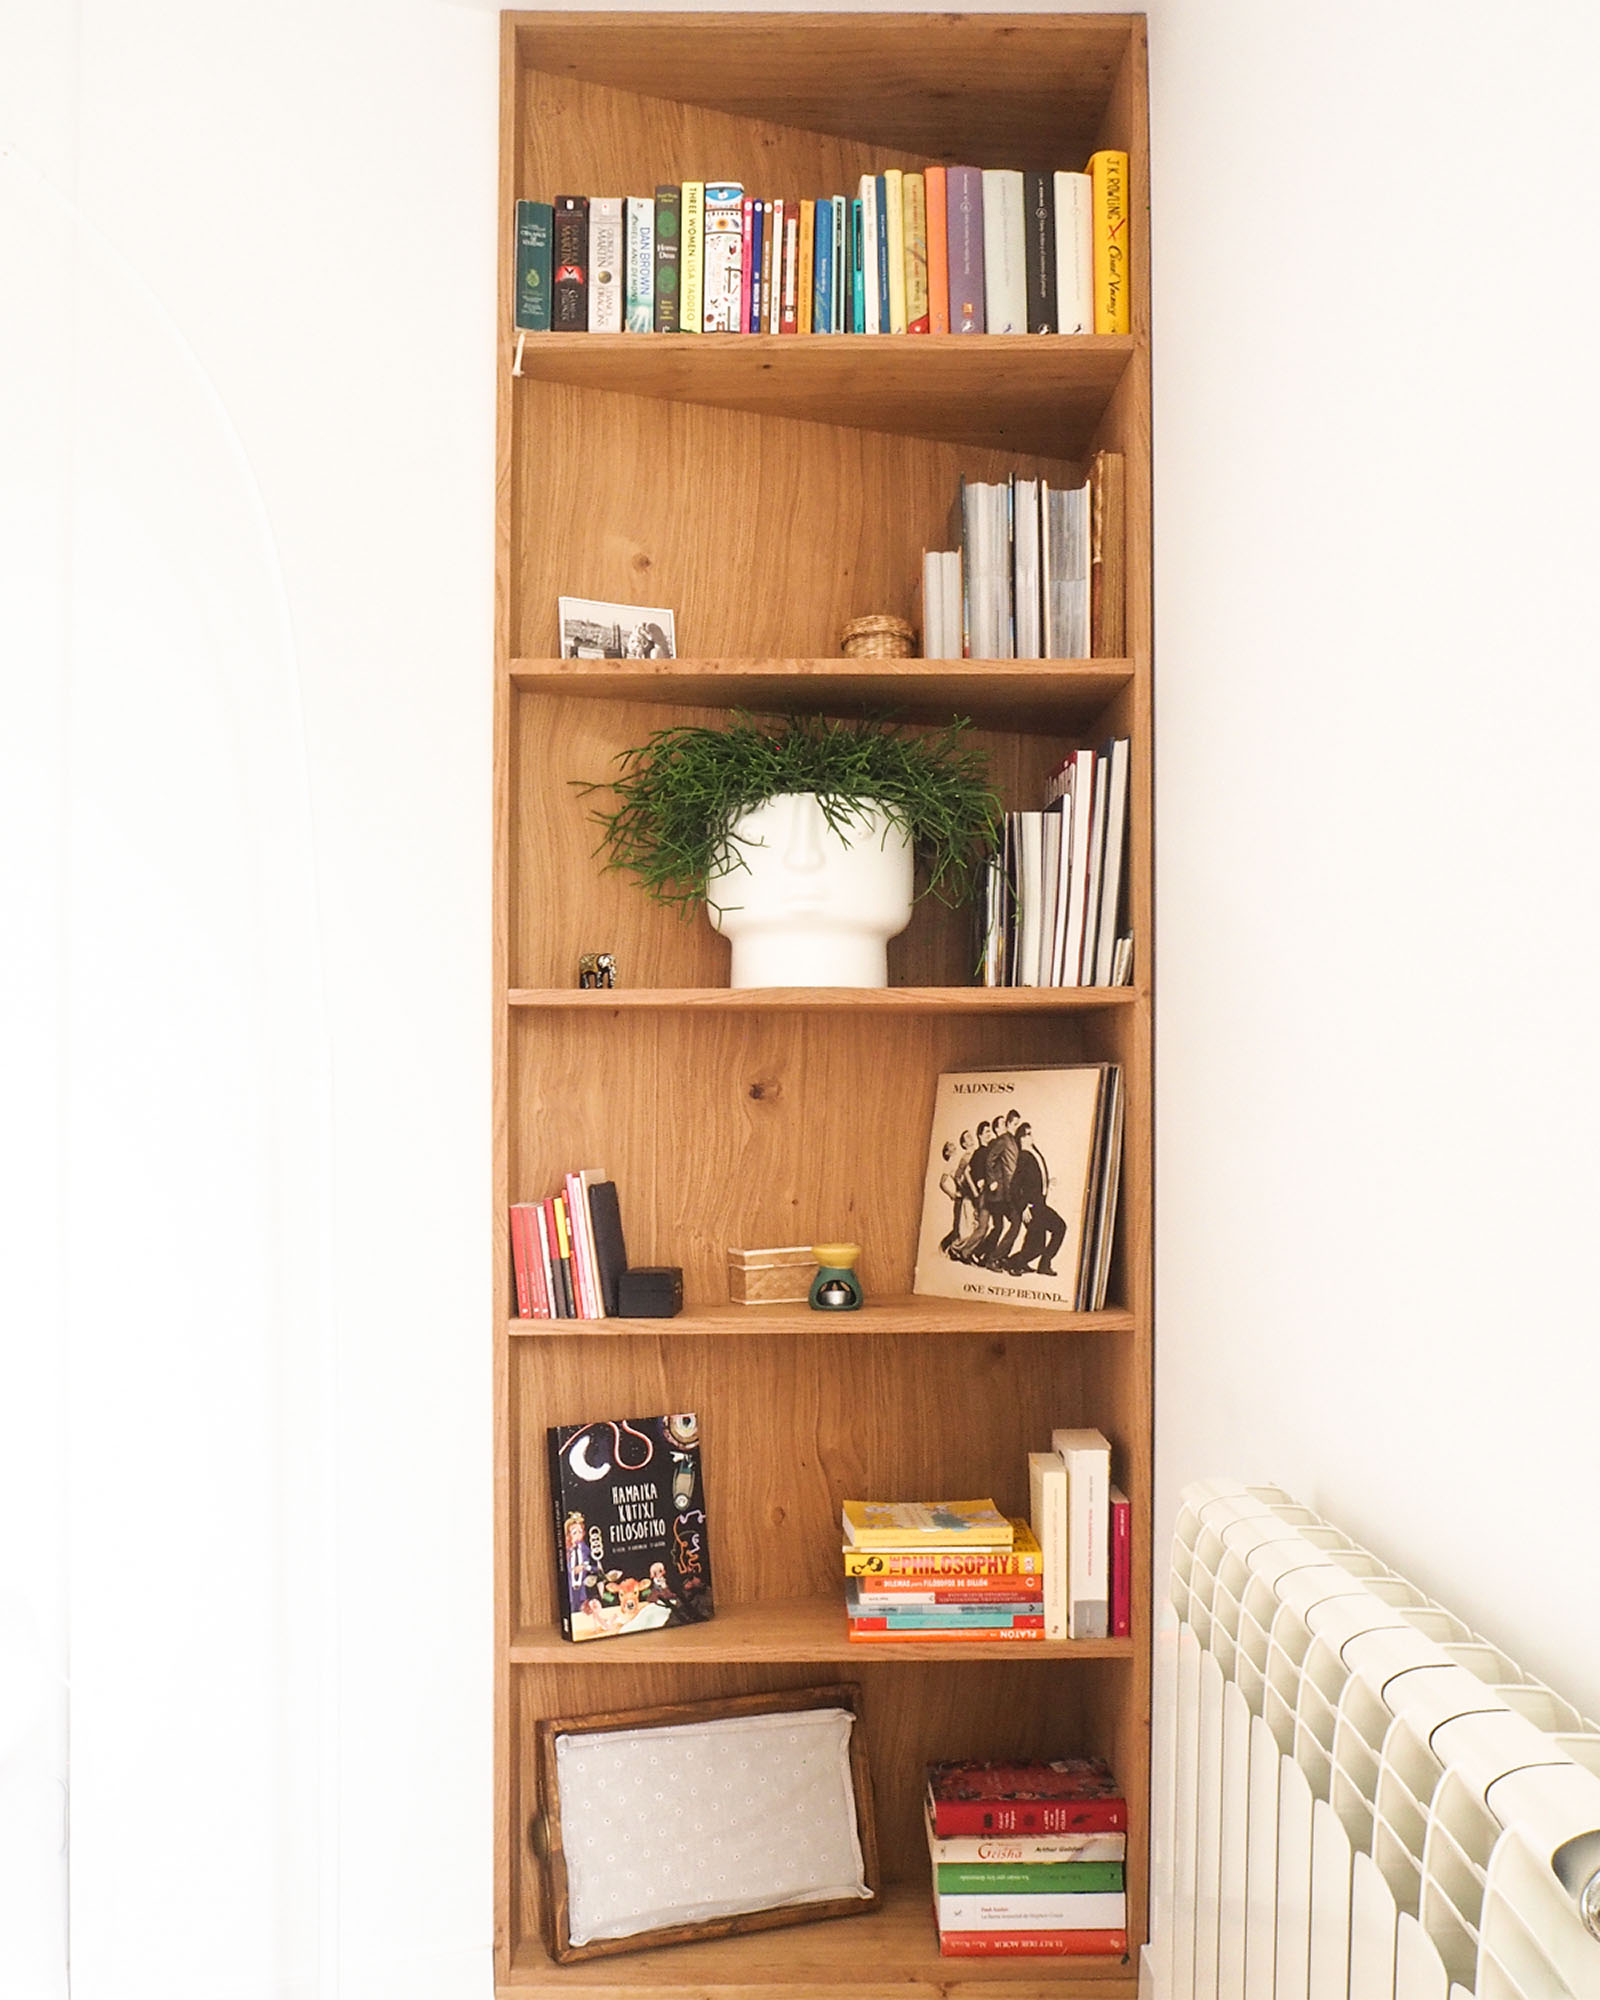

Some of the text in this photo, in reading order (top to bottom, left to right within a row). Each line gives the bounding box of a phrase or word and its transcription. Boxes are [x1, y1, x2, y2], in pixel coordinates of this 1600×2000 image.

[1107, 167, 1120, 175] K
[1107, 177, 1121, 221] ROWLING
[560, 224, 571, 266] MARTIN
[597, 227, 606, 268] MARTIN
[687, 187, 697, 322] THREE WOMEN LISA TADDEO
[630, 213, 639, 304] ANGELS AND DEMONS
[640, 227, 651, 295] DAN BROWN
[597, 287, 605, 327] DRAGONS
[1107, 280, 1121, 317] Vacancy
[952, 1082, 1015, 1094] MADNESS
[963, 1283, 1069, 1304] ONE STEP BEYOND...
[612, 1483, 658, 1504] HAMAIKA
[618, 1502, 654, 1522] KUTIXI
[610, 1519, 666, 1543] FILOSOFIKO
[889, 1556, 900, 1575] THE
[901, 1555, 1009, 1575] PHILOSOPHY
[884, 1579, 910, 1588] DILEMAS
[957, 1579, 965, 1587] DE
[1000, 1629, 1037, 1640] PLATÓN
[978, 1843, 1023, 1860] Geisha
